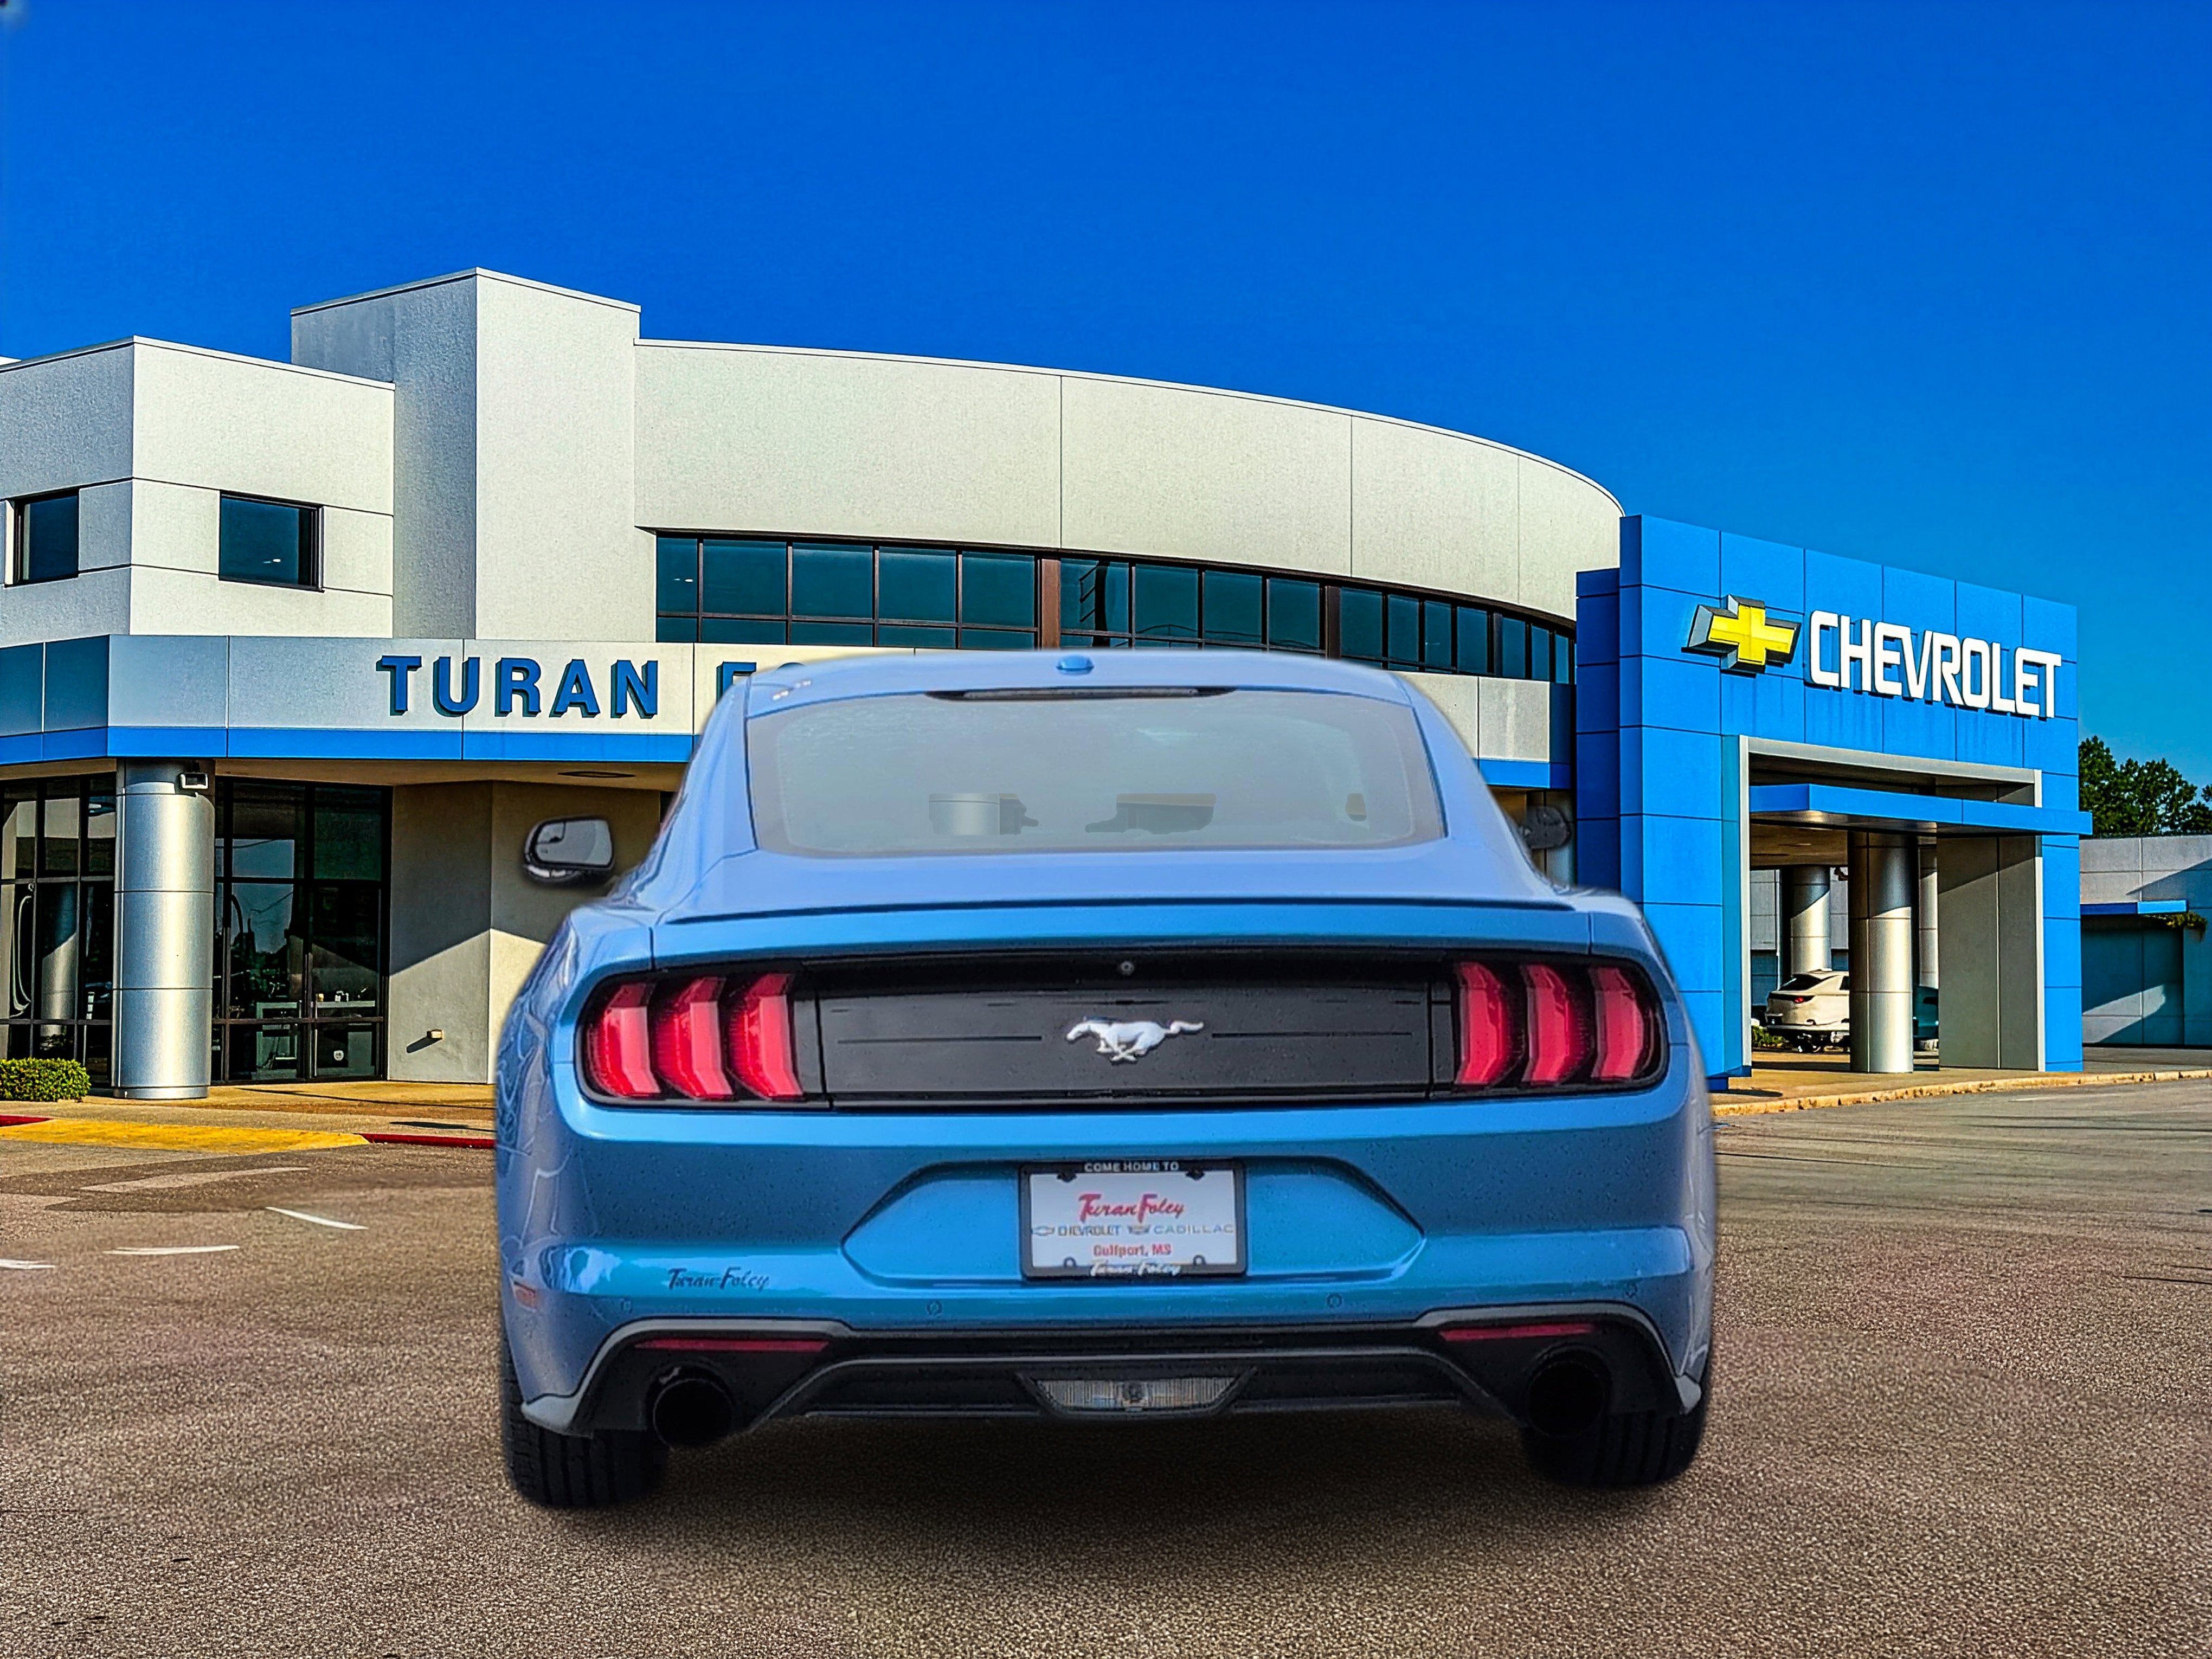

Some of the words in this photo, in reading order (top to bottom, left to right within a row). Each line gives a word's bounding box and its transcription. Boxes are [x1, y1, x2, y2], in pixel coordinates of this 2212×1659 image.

[1809, 610, 2062, 719] CHEVROLET
[377, 654, 659, 719] TURAN
[1084, 1162, 1120, 1172] COME
[1122, 1161, 1160, 1172] HOME
[1161, 1161, 1179, 1171] TO
[1078, 1193, 1137, 1223] Turan
[1137, 1193, 1184, 1223] Foley
[1058, 1225, 1121, 1236] CHEVROLET
[1154, 1223, 1234, 1234] CADILLAC
[1093, 1244, 1148, 1257] Gulfport,
[1152, 1244, 1172, 1255] MS
[668, 1268, 721, 1290] Turan
[719, 1266, 769, 1292] Foley
